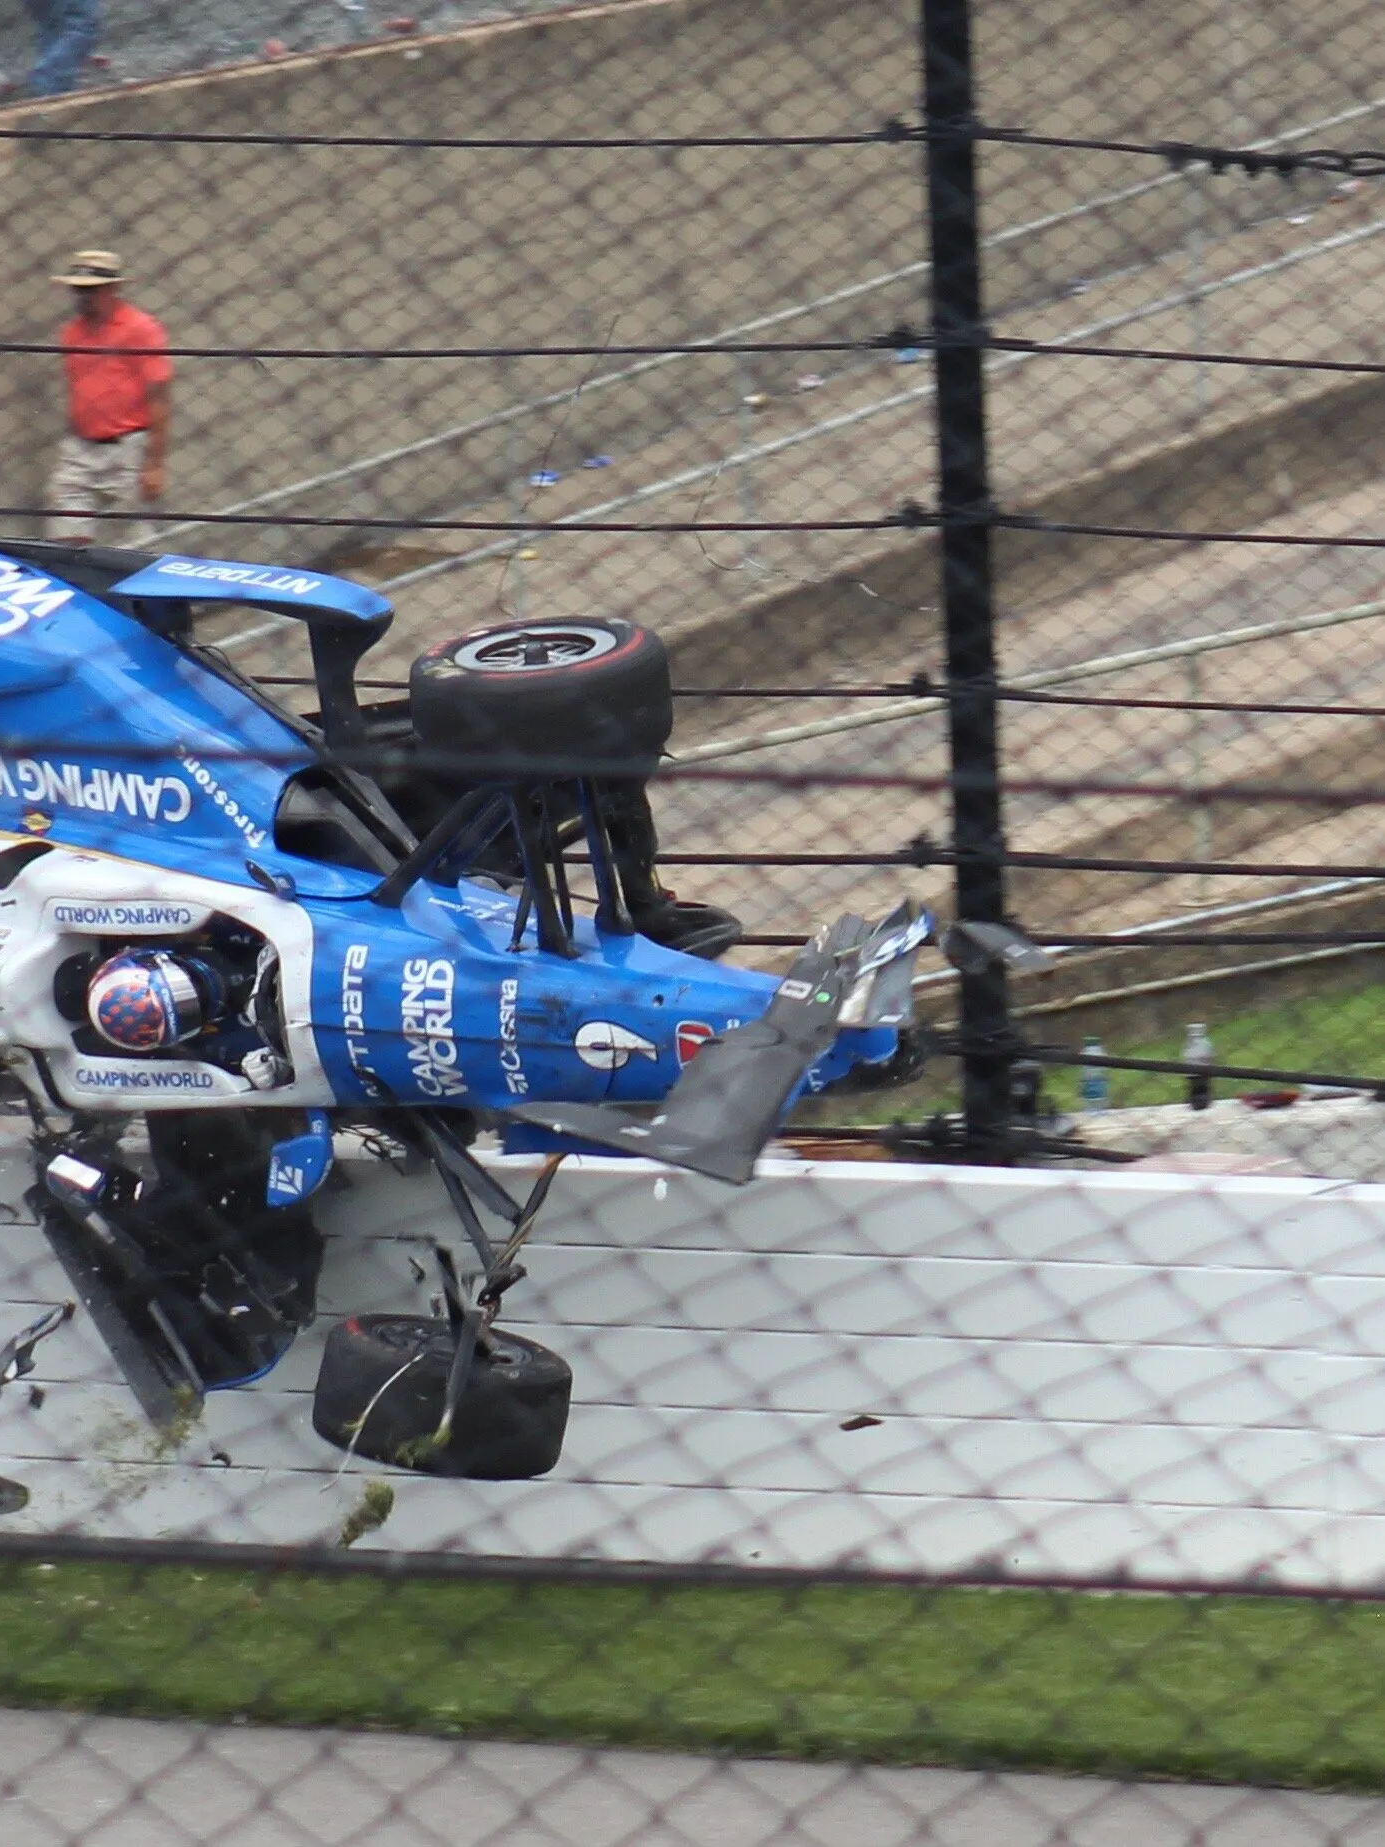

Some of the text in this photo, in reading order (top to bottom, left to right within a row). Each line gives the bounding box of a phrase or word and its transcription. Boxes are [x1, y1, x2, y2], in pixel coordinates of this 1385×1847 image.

[20, 759, 192, 823] CAMPING
[54, 905, 192, 926] CAMPING WORLD
[400, 958, 444, 1097] CAMPING
[425, 959, 470, 1097] WORLD
[76, 1069, 214, 1090] CAMPING WORLD
